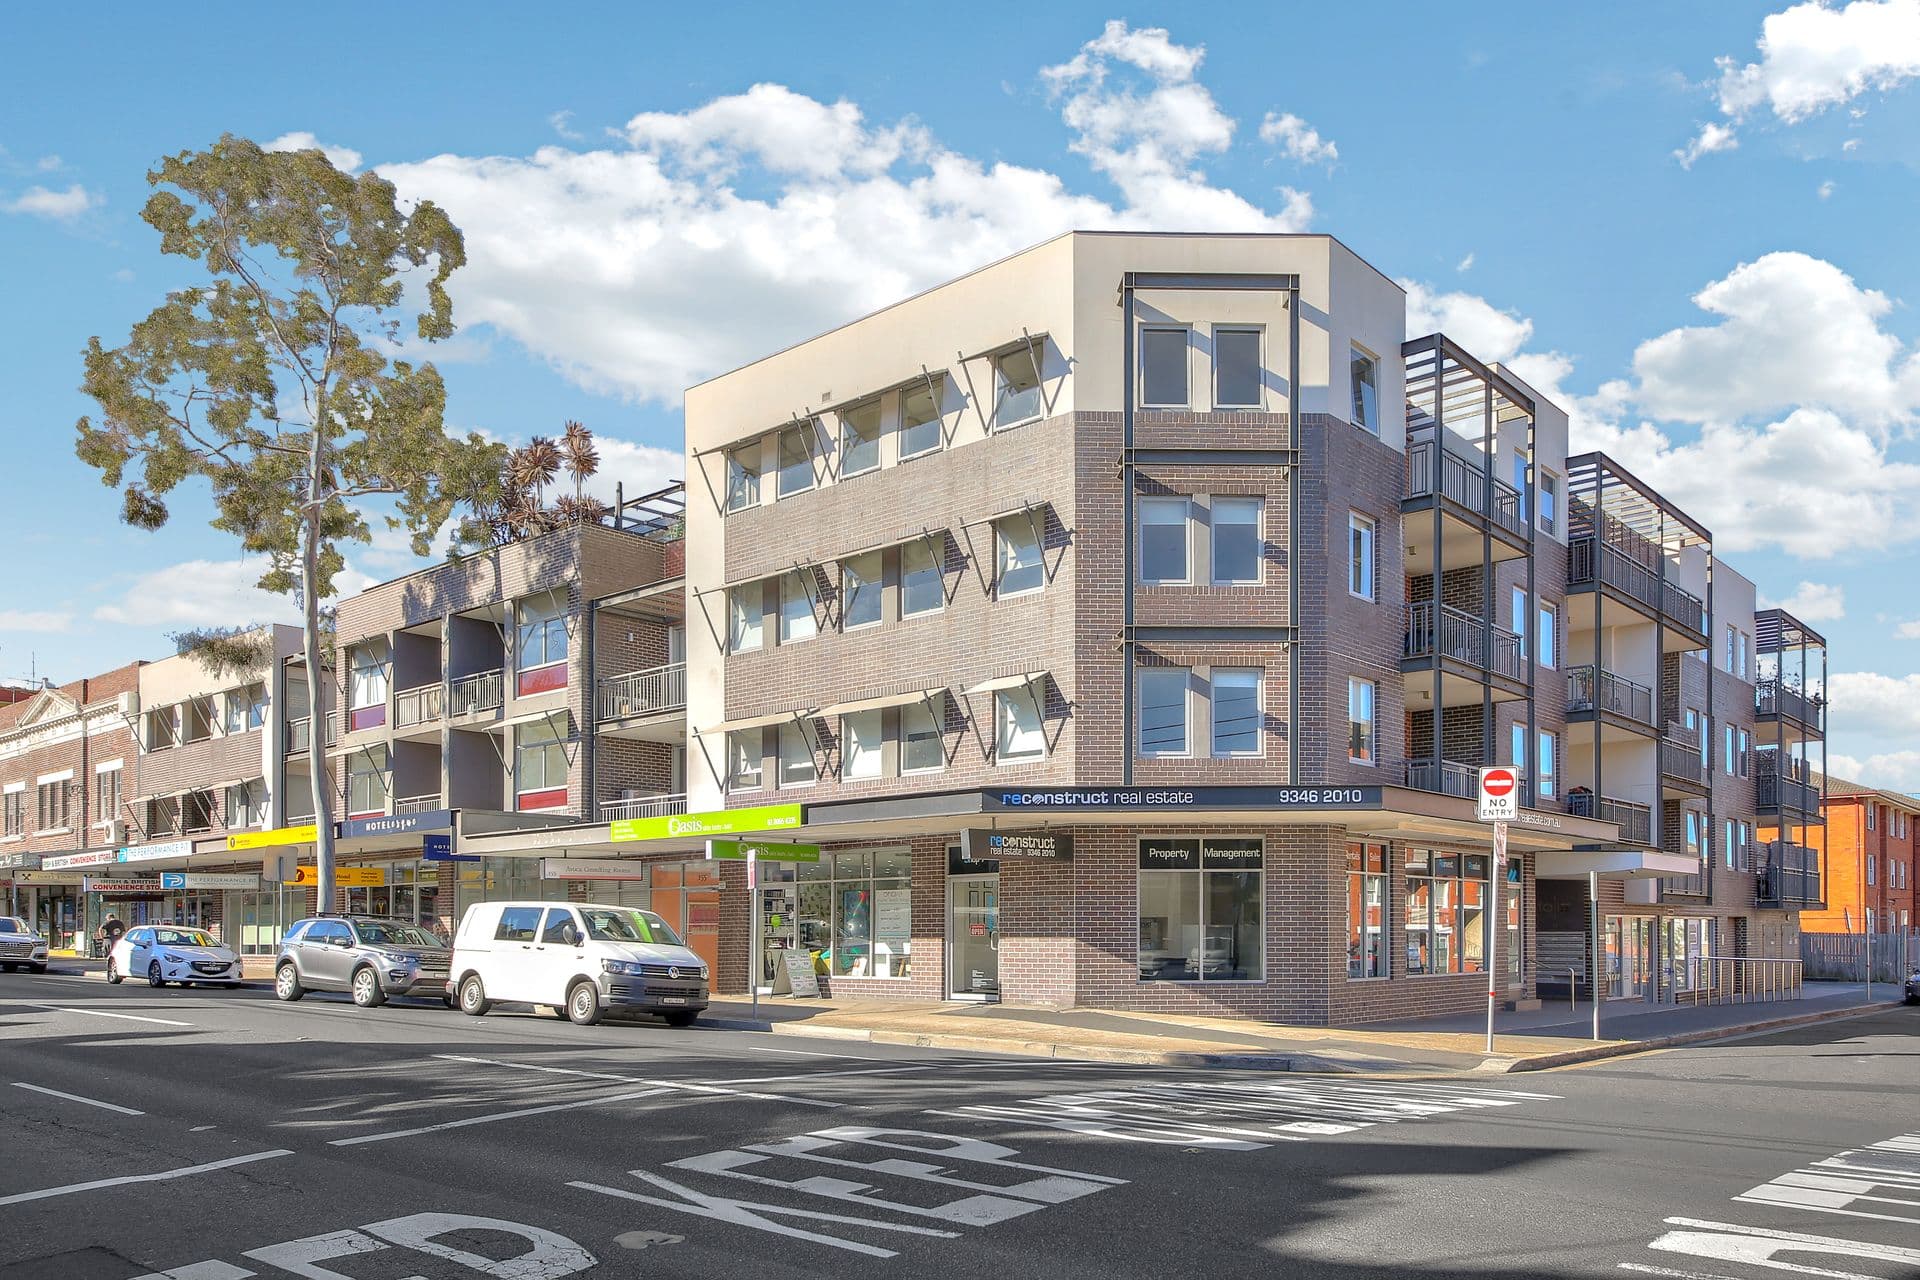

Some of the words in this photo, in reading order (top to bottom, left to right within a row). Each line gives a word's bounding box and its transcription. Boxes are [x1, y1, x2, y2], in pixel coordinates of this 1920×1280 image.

[1002, 791, 1108, 805] reconstruct
[1113, 791, 1142, 804] real
[1146, 791, 1193, 804] estate
[1279, 789, 1318, 803] 9346
[1322, 789, 1362, 803] 2010
[1489, 799, 1507, 807] NO
[668, 816, 703, 834] Oasis
[990, 835, 1055, 849] reconstruct
[739, 843, 769, 856] Osis
[990, 847, 1002, 855] real
[1003, 848, 1023, 856] estate
[1027, 849, 1041, 857] 9346
[1042, 849, 1055, 857] 2010
[1149, 848, 1189, 860] Property
[1204, 848, 1261, 859] Management
[564, 1126, 1132, 1258] KEEP
